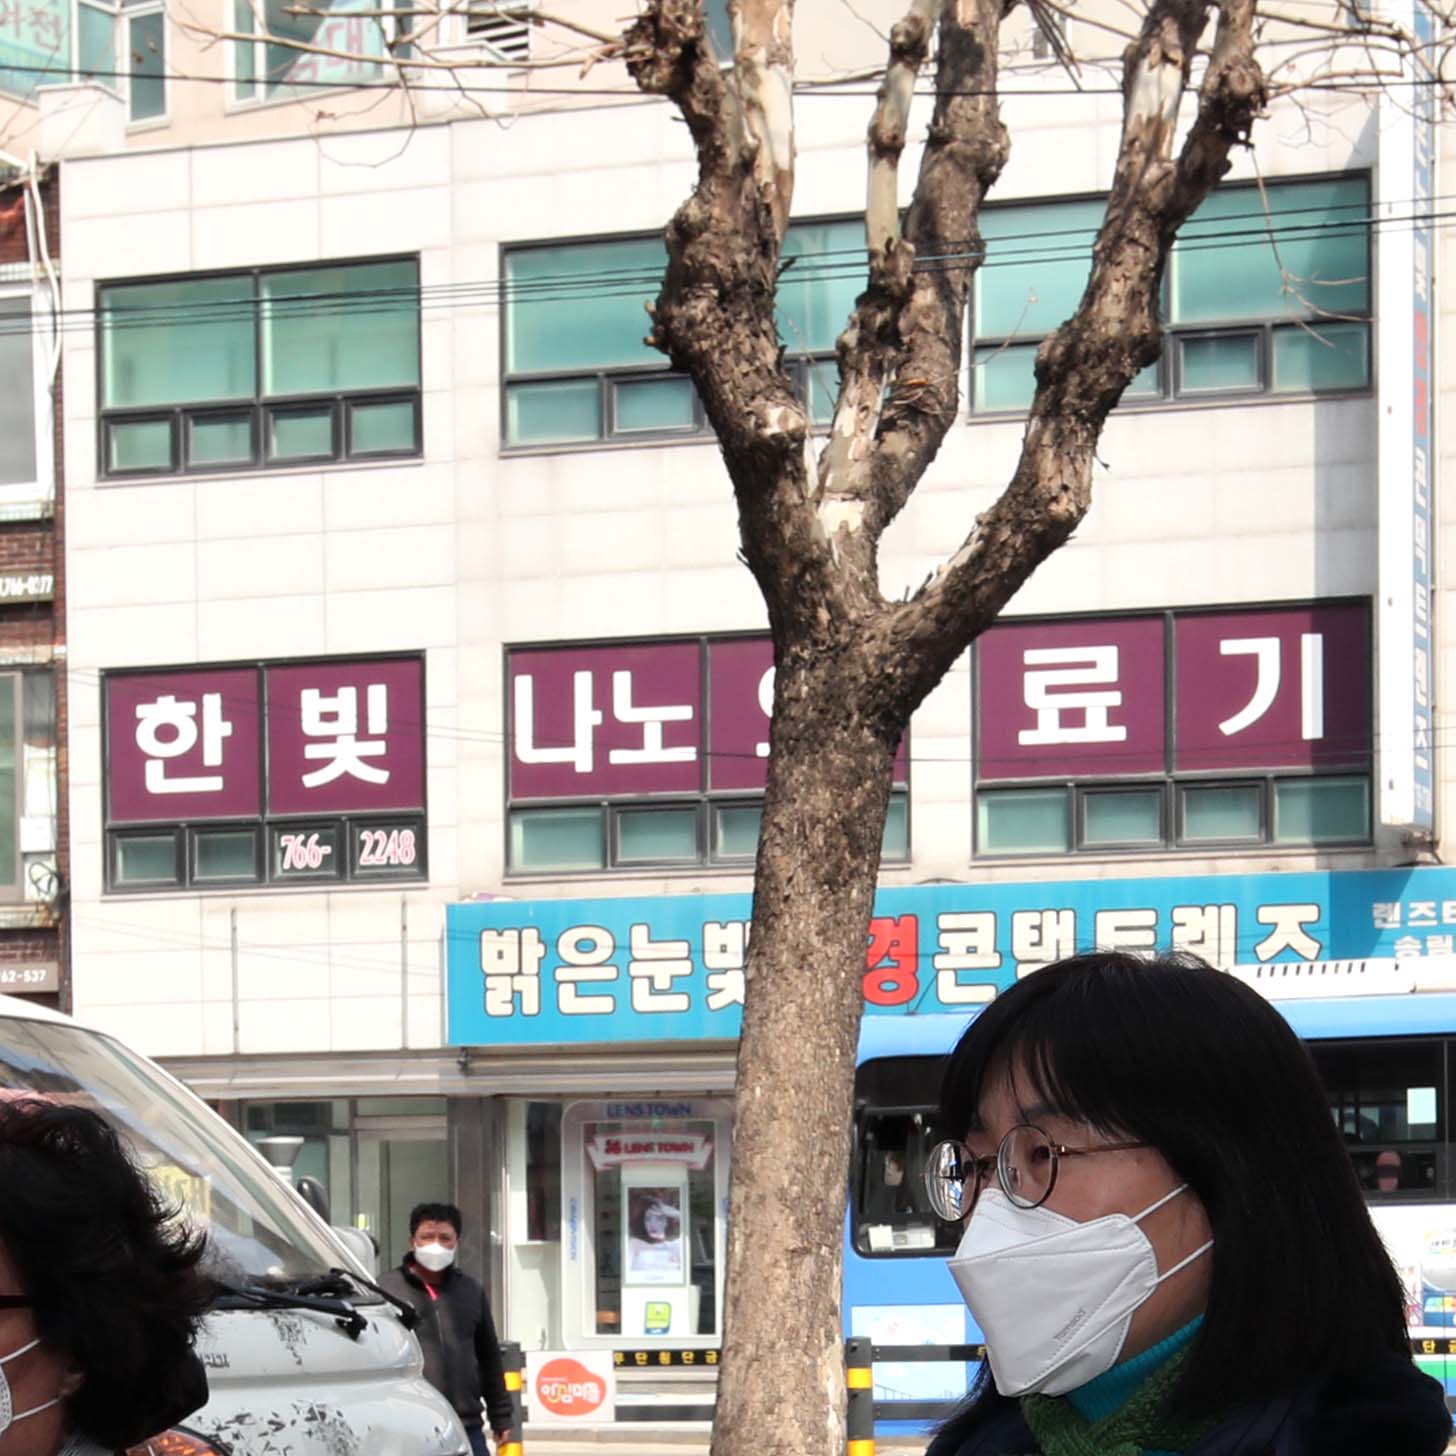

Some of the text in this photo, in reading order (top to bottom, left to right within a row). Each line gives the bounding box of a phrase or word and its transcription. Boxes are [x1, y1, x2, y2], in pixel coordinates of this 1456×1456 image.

[135, 682, 391, 795] 한빛
[513, 670, 698, 774] 나노
[280, 828, 418, 871] 766-2248
[607, 1103, 691, 1117] LENS TOWN
